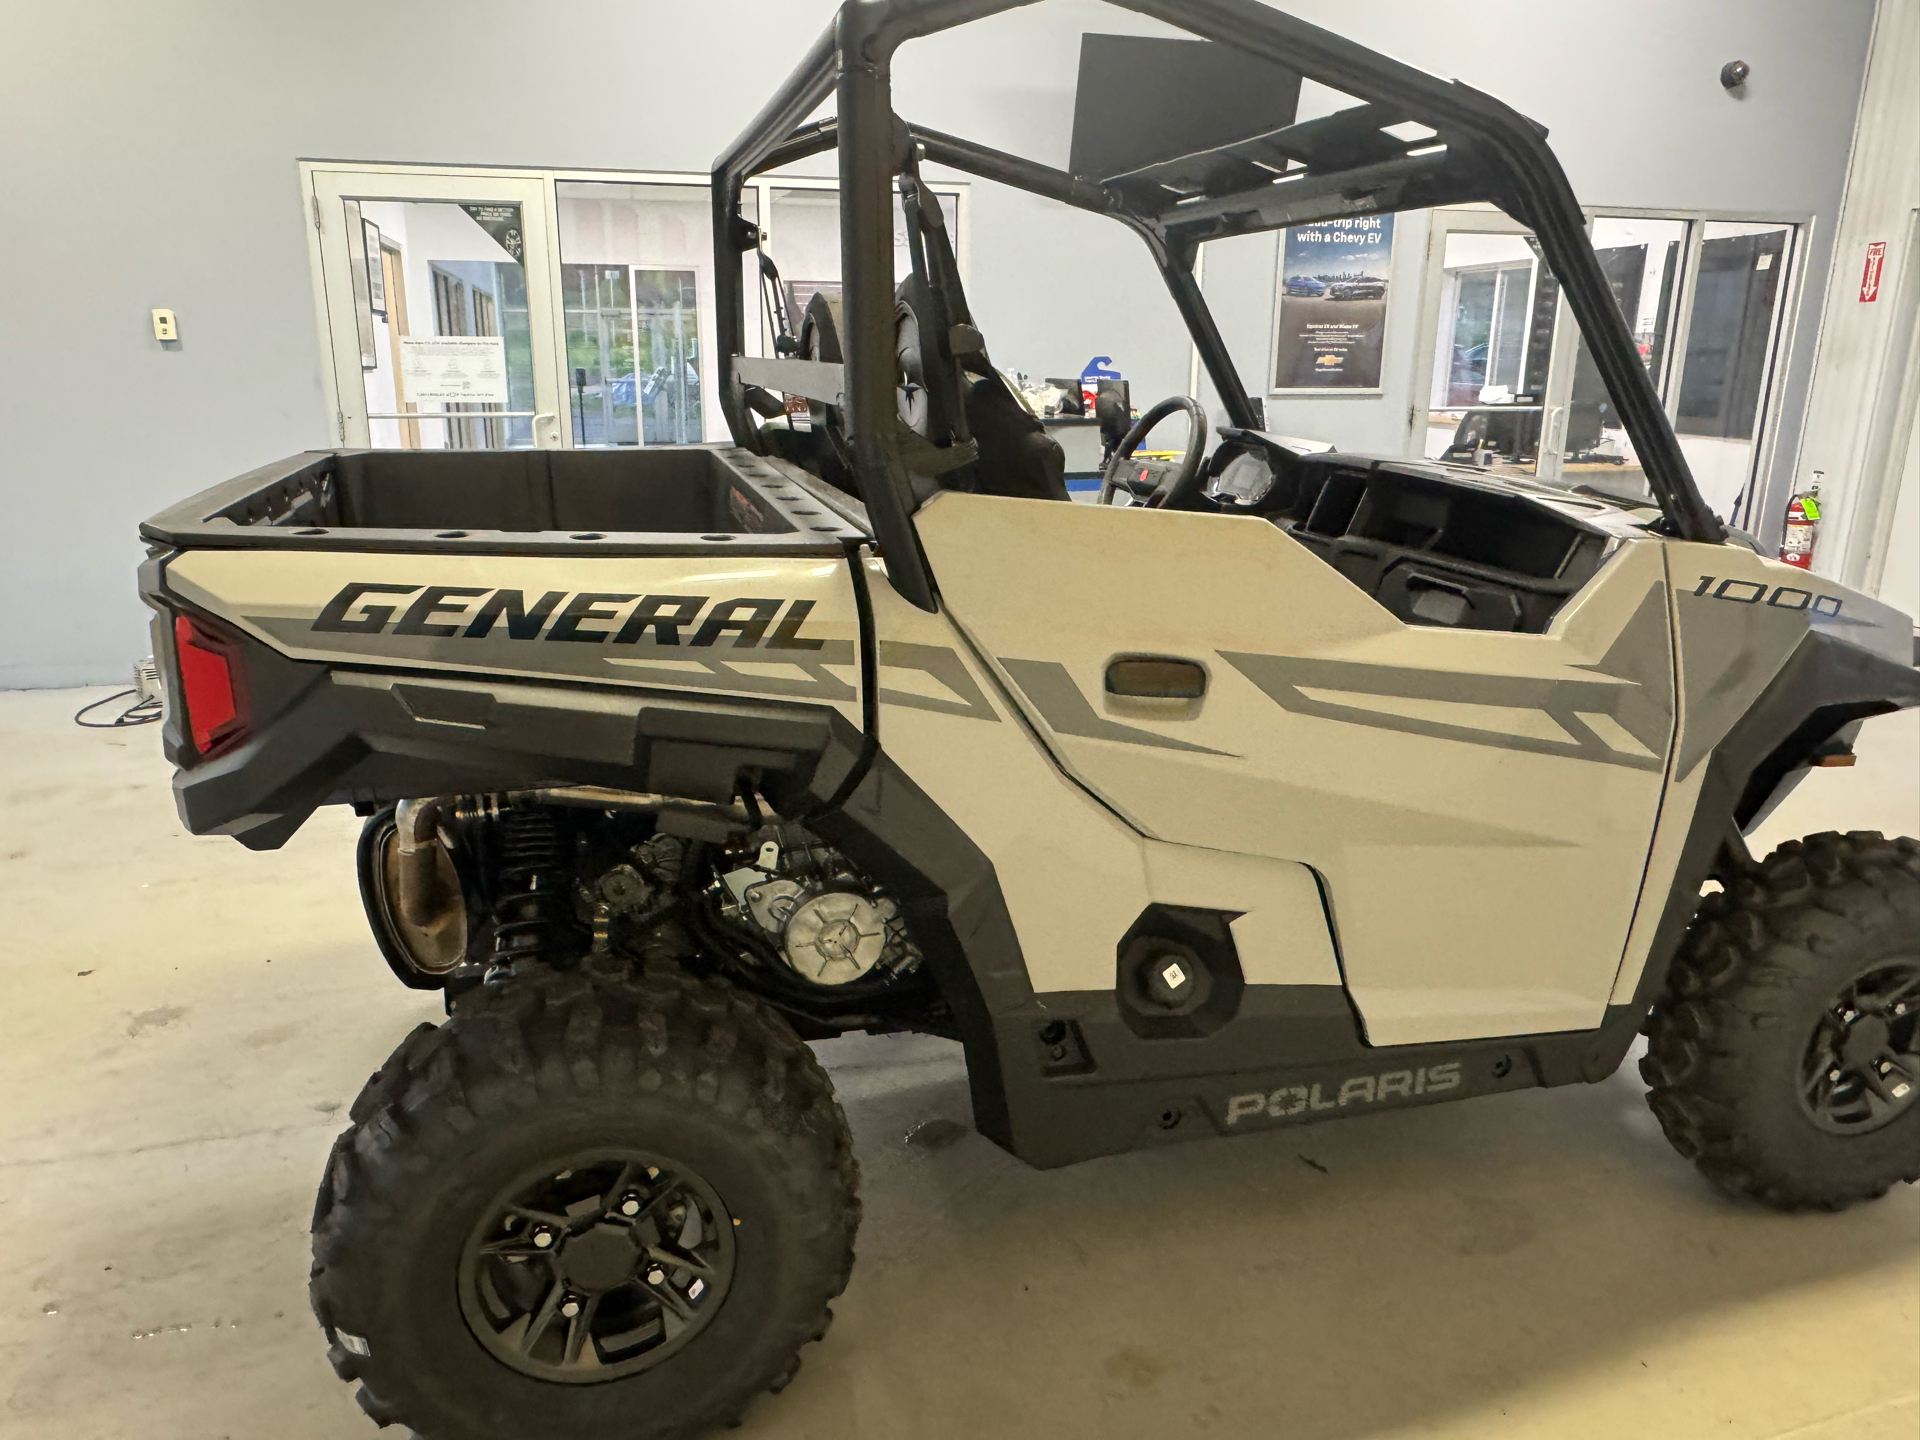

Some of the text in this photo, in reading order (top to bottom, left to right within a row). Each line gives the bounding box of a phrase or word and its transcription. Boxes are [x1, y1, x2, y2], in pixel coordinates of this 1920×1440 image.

[1297, 230, 1382, 245] with a Chevy EV
[1355, 216, 1381, 230] right
[310, 582, 827, 650] GENERAL
[1693, 575, 1843, 617] 1000
[1225, 1062, 1461, 1125] POLARIS
